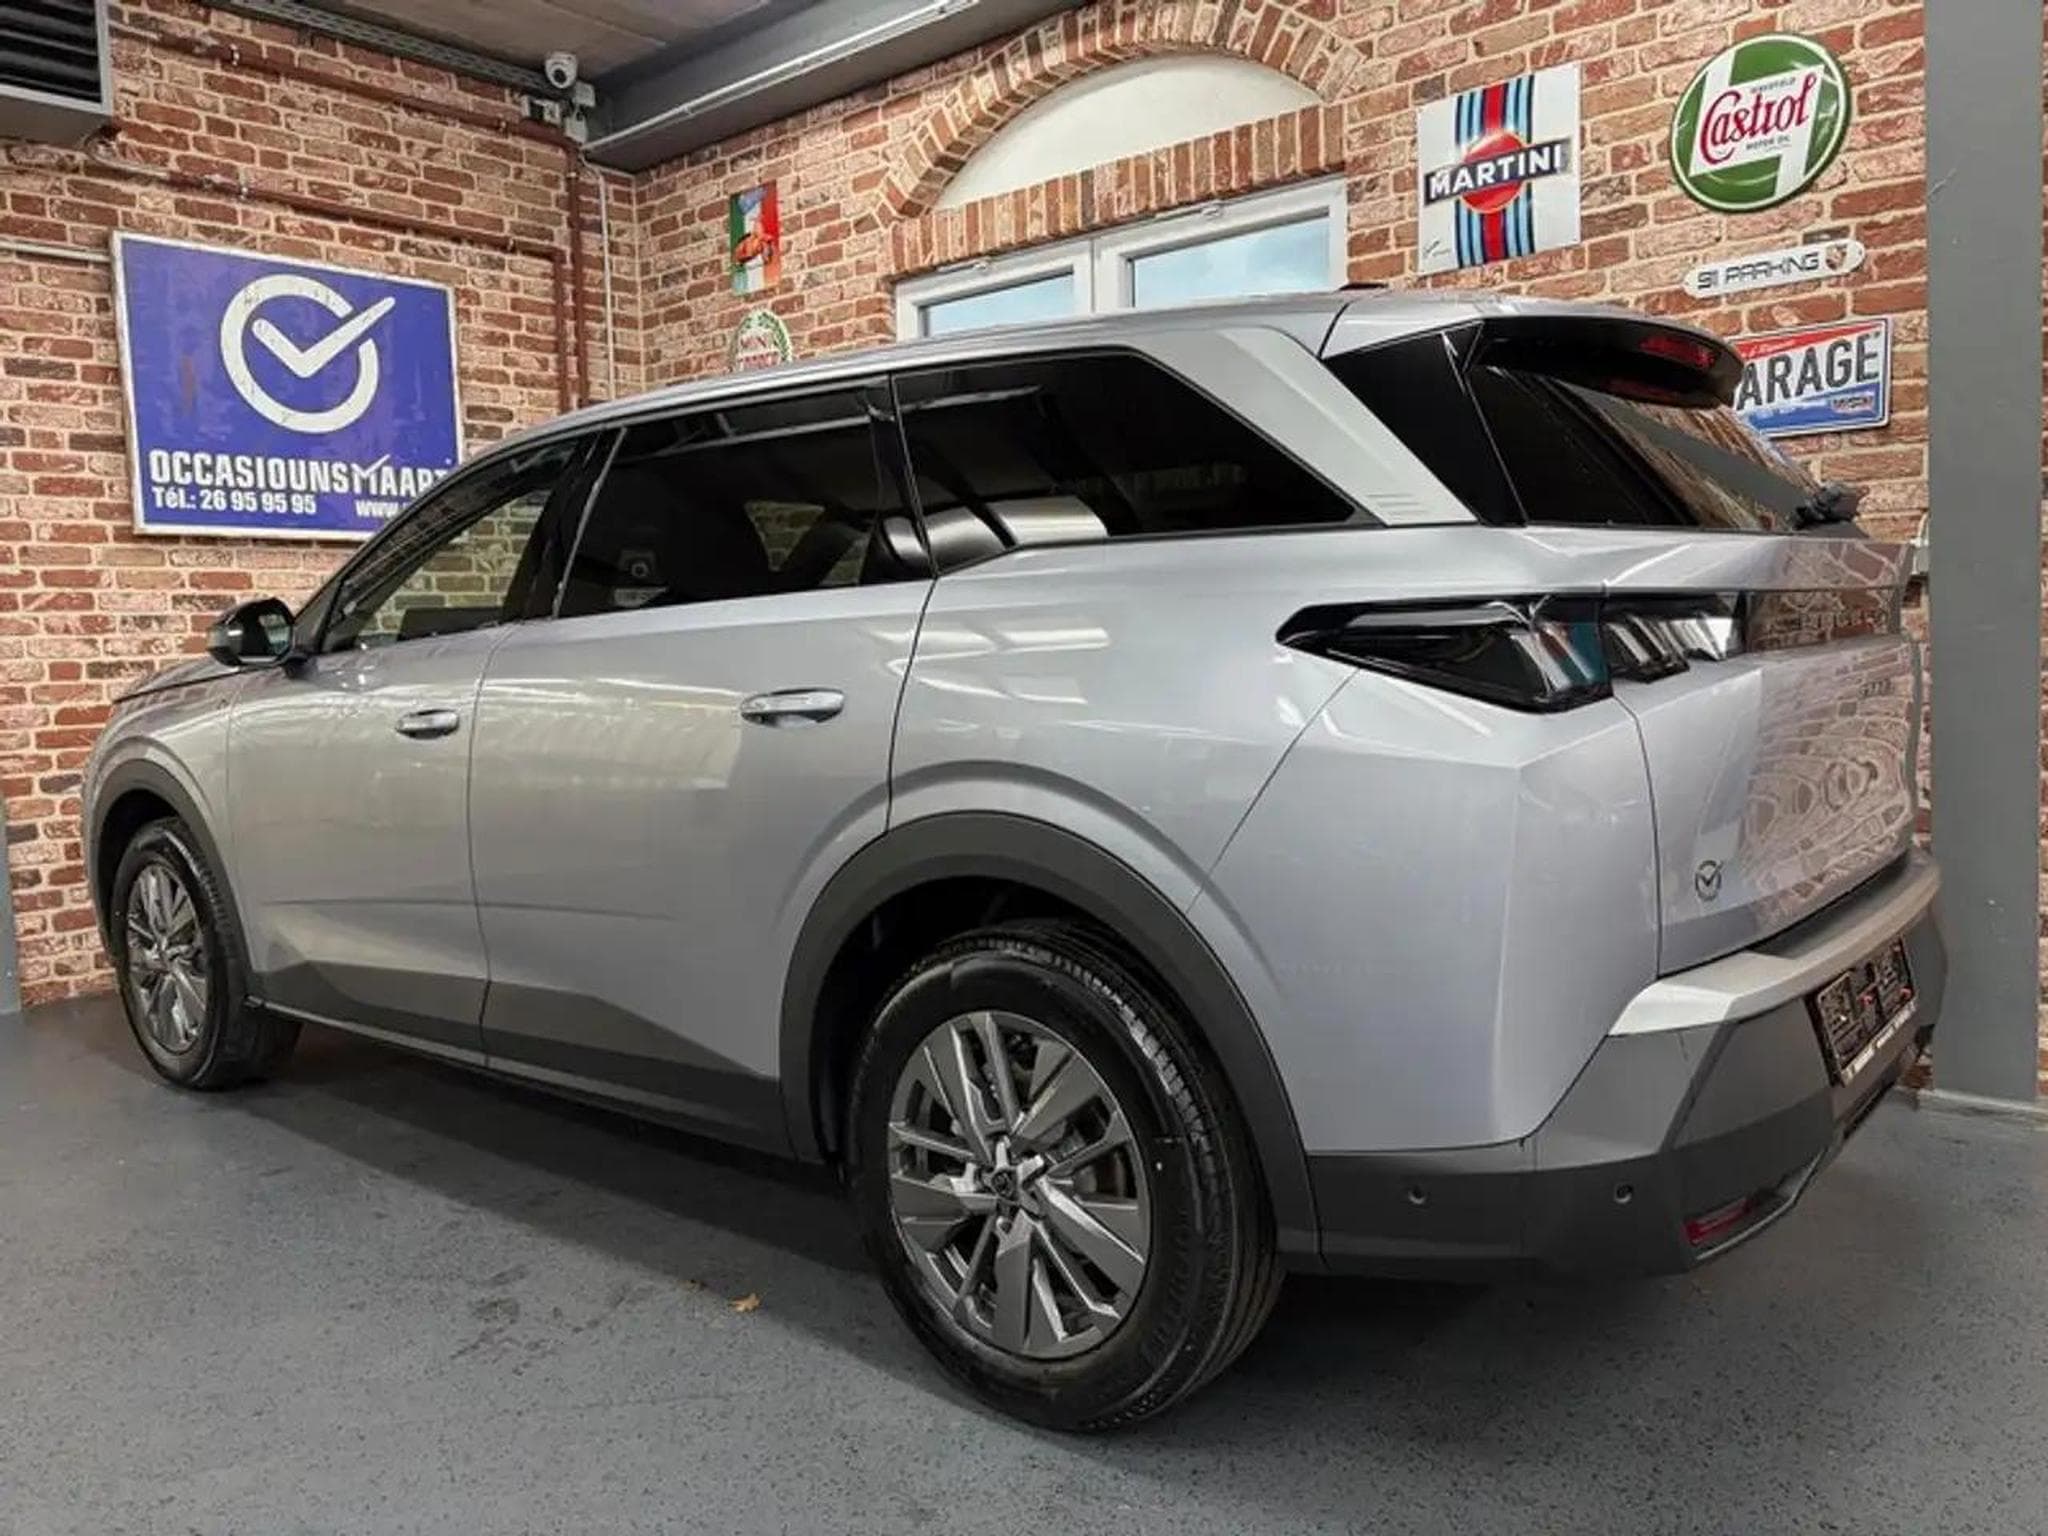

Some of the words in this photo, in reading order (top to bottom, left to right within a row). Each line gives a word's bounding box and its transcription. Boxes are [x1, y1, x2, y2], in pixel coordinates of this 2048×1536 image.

[1700, 73, 1817, 164] Castrol
[1430, 144, 1562, 199] MARTINI
[1725, 252, 1820, 284] PARKING
[1736, 331, 1880, 411] ARAGE
[201, 488, 227, 511] 26
[231, 490, 257, 512] 95
[262, 491, 288, 513] 95
[292, 493, 317, 515] 95
